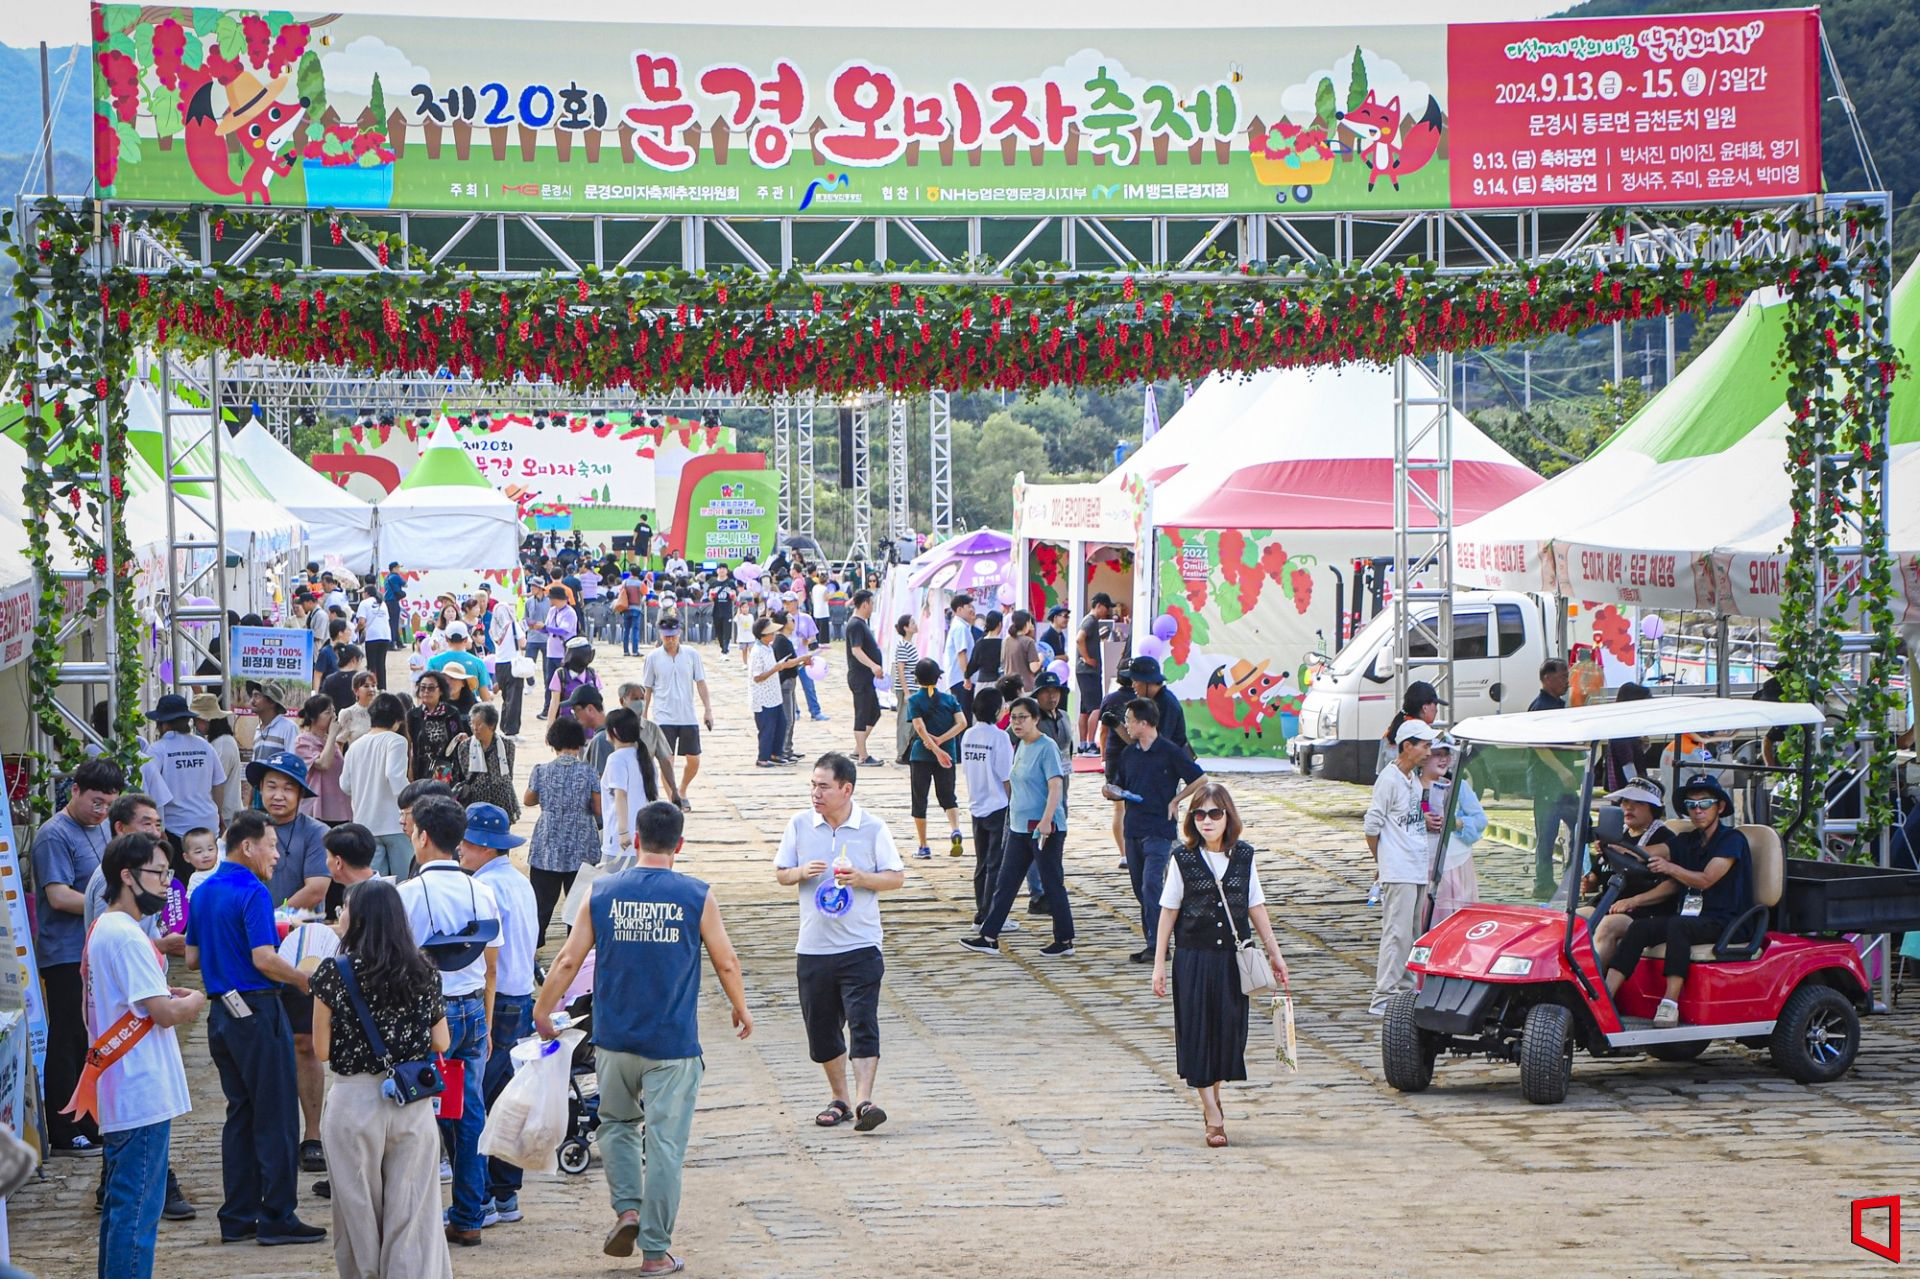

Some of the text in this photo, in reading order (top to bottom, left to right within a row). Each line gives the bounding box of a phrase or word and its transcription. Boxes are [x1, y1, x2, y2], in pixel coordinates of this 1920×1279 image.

[1504, 39, 1568, 62] 다섯가지
[1570, 36, 1602, 59] 맛의
[411, 81, 608, 130] 제20회
[1529, 106, 1736, 136] 문경시 동로면 금천둔치 일원
[1473, 153, 1507, 170] 9.13.
[1512, 151, 1536, 169] (금)
[1541, 148, 1597, 168] 축하공연
[1621, 145, 1665, 165] 박서진,
[1671, 142, 1715, 163] 마이진,
[1770, 139, 1798, 160] 영기
[1473, 178, 1507, 196] 9.14.
[1512, 177, 1536, 195] (토)
[1541, 174, 1597, 193] 축하공연
[1621, 172, 1666, 191] 정서주,
[1671, 170, 1701, 188] 주미,
[1757, 165, 1800, 185] 박미영
[541, 184, 572, 197] 문경시
[584, 184, 740, 200] 문경오미자축제추진위원회
[463, 440, 513, 452] 제20회
[1183, 549, 1208, 558] 2024
[1582, 551, 1676, 587] 오미자 세척 담금 체험장
[1750, 560, 1780, 596] 오미자
[243, 646, 302, 657] 사탕수수 100%
[242, 656, 302, 670] 비정제 원당!
[964, 751, 986, 761] STAFF
[175, 759, 204, 769] STAFF
[614, 917, 644, 930] SPORTS
[644, 919, 652, 930] is
[613, 928, 680, 943] ATHLETIC CLUB
